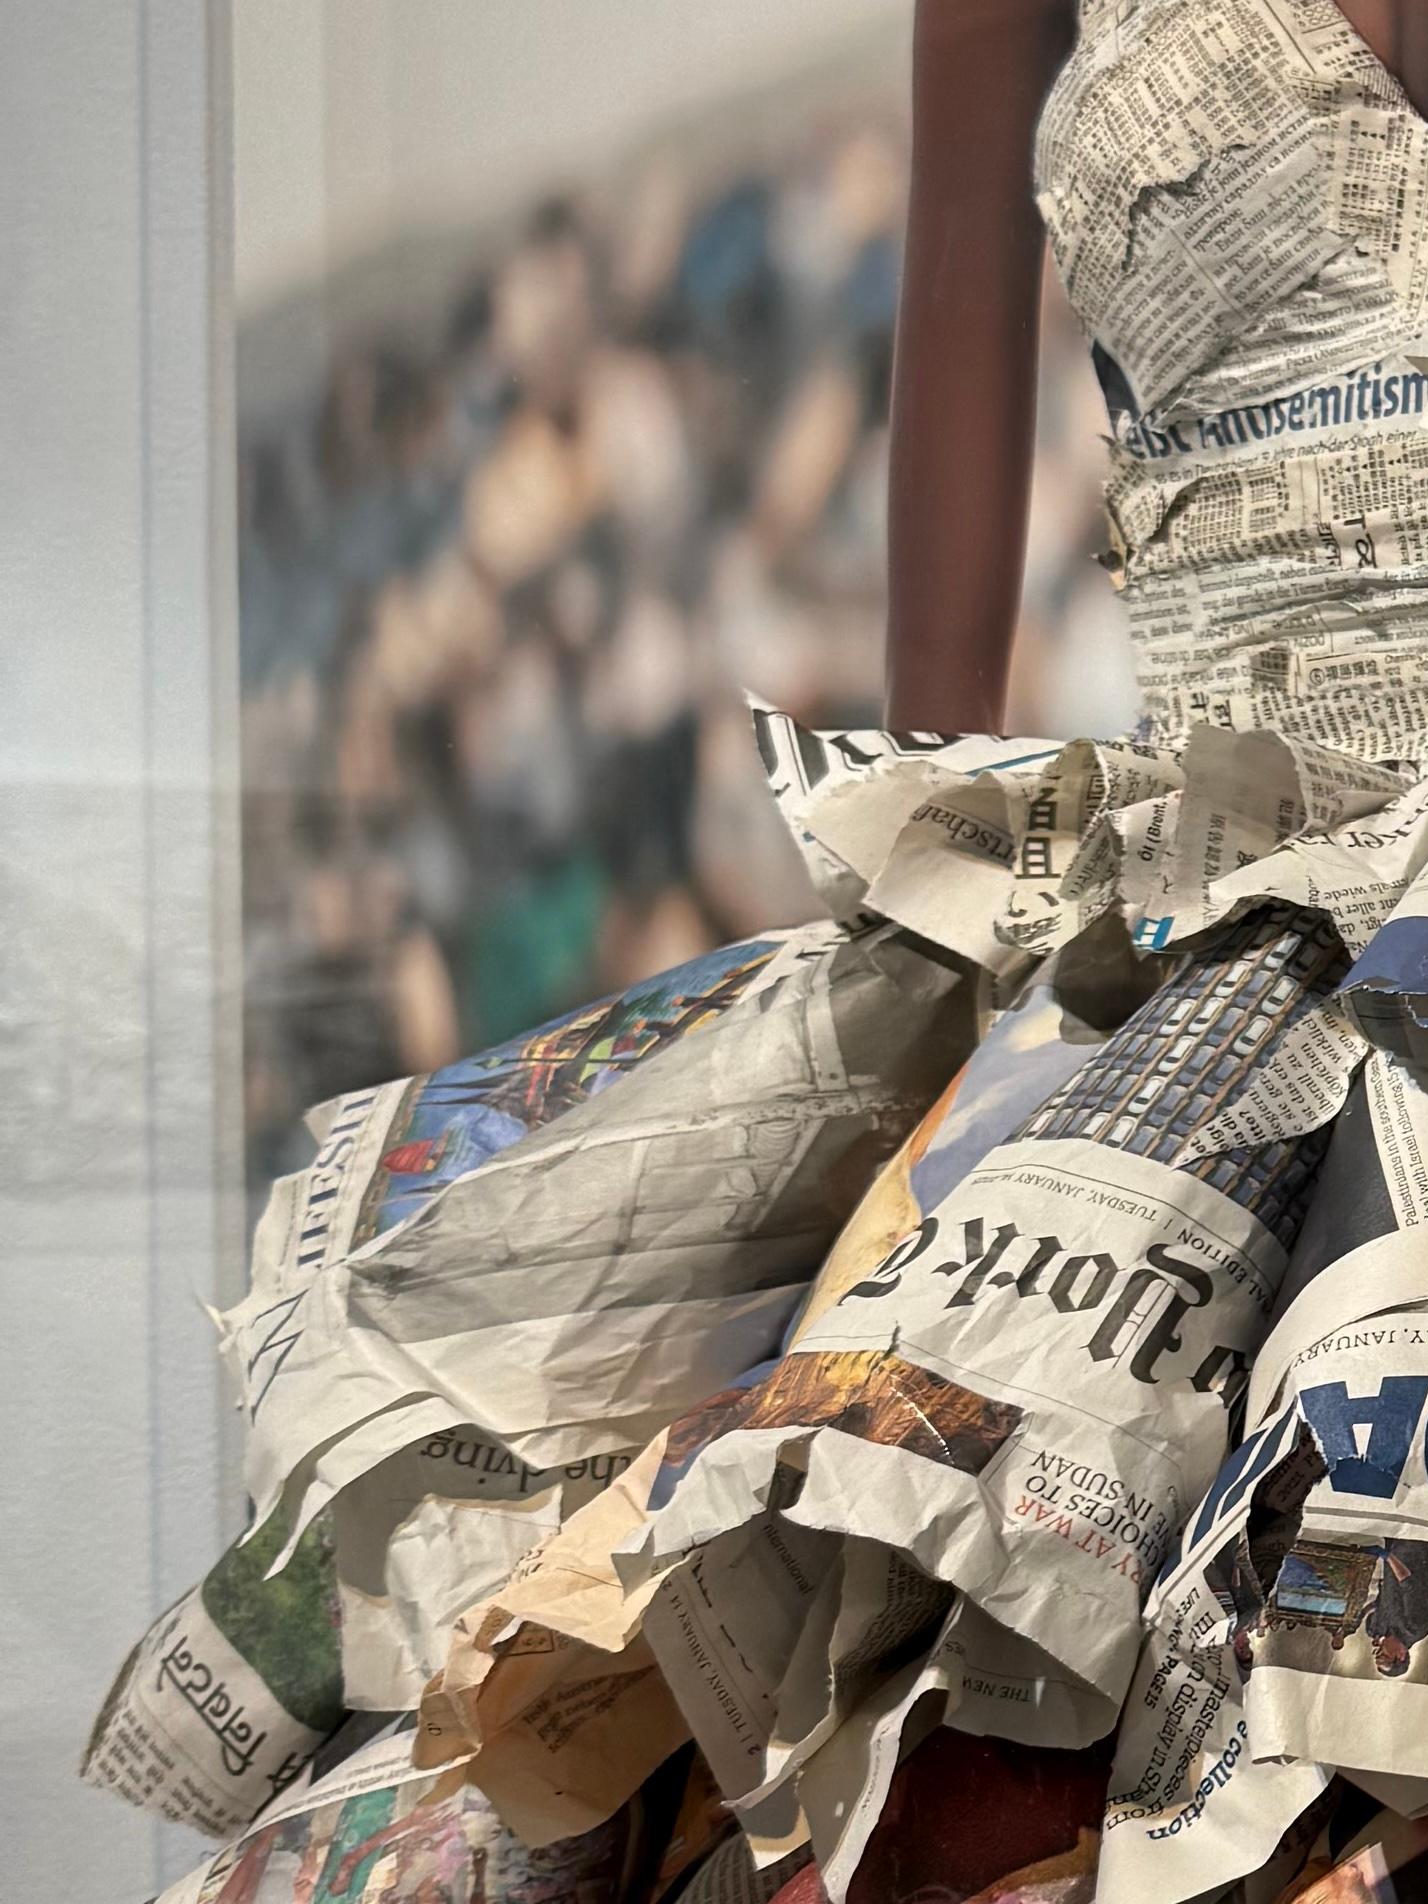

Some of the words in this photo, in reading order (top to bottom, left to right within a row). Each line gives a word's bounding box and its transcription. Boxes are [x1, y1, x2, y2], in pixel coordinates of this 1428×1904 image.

[1086, 1189, 1157, 1221] TUESDAY,
[1024, 1475, 1062, 1504] TO
[1030, 1450, 1125, 1508] SUDAN
[1007, 1494, 1074, 1539] WAR
